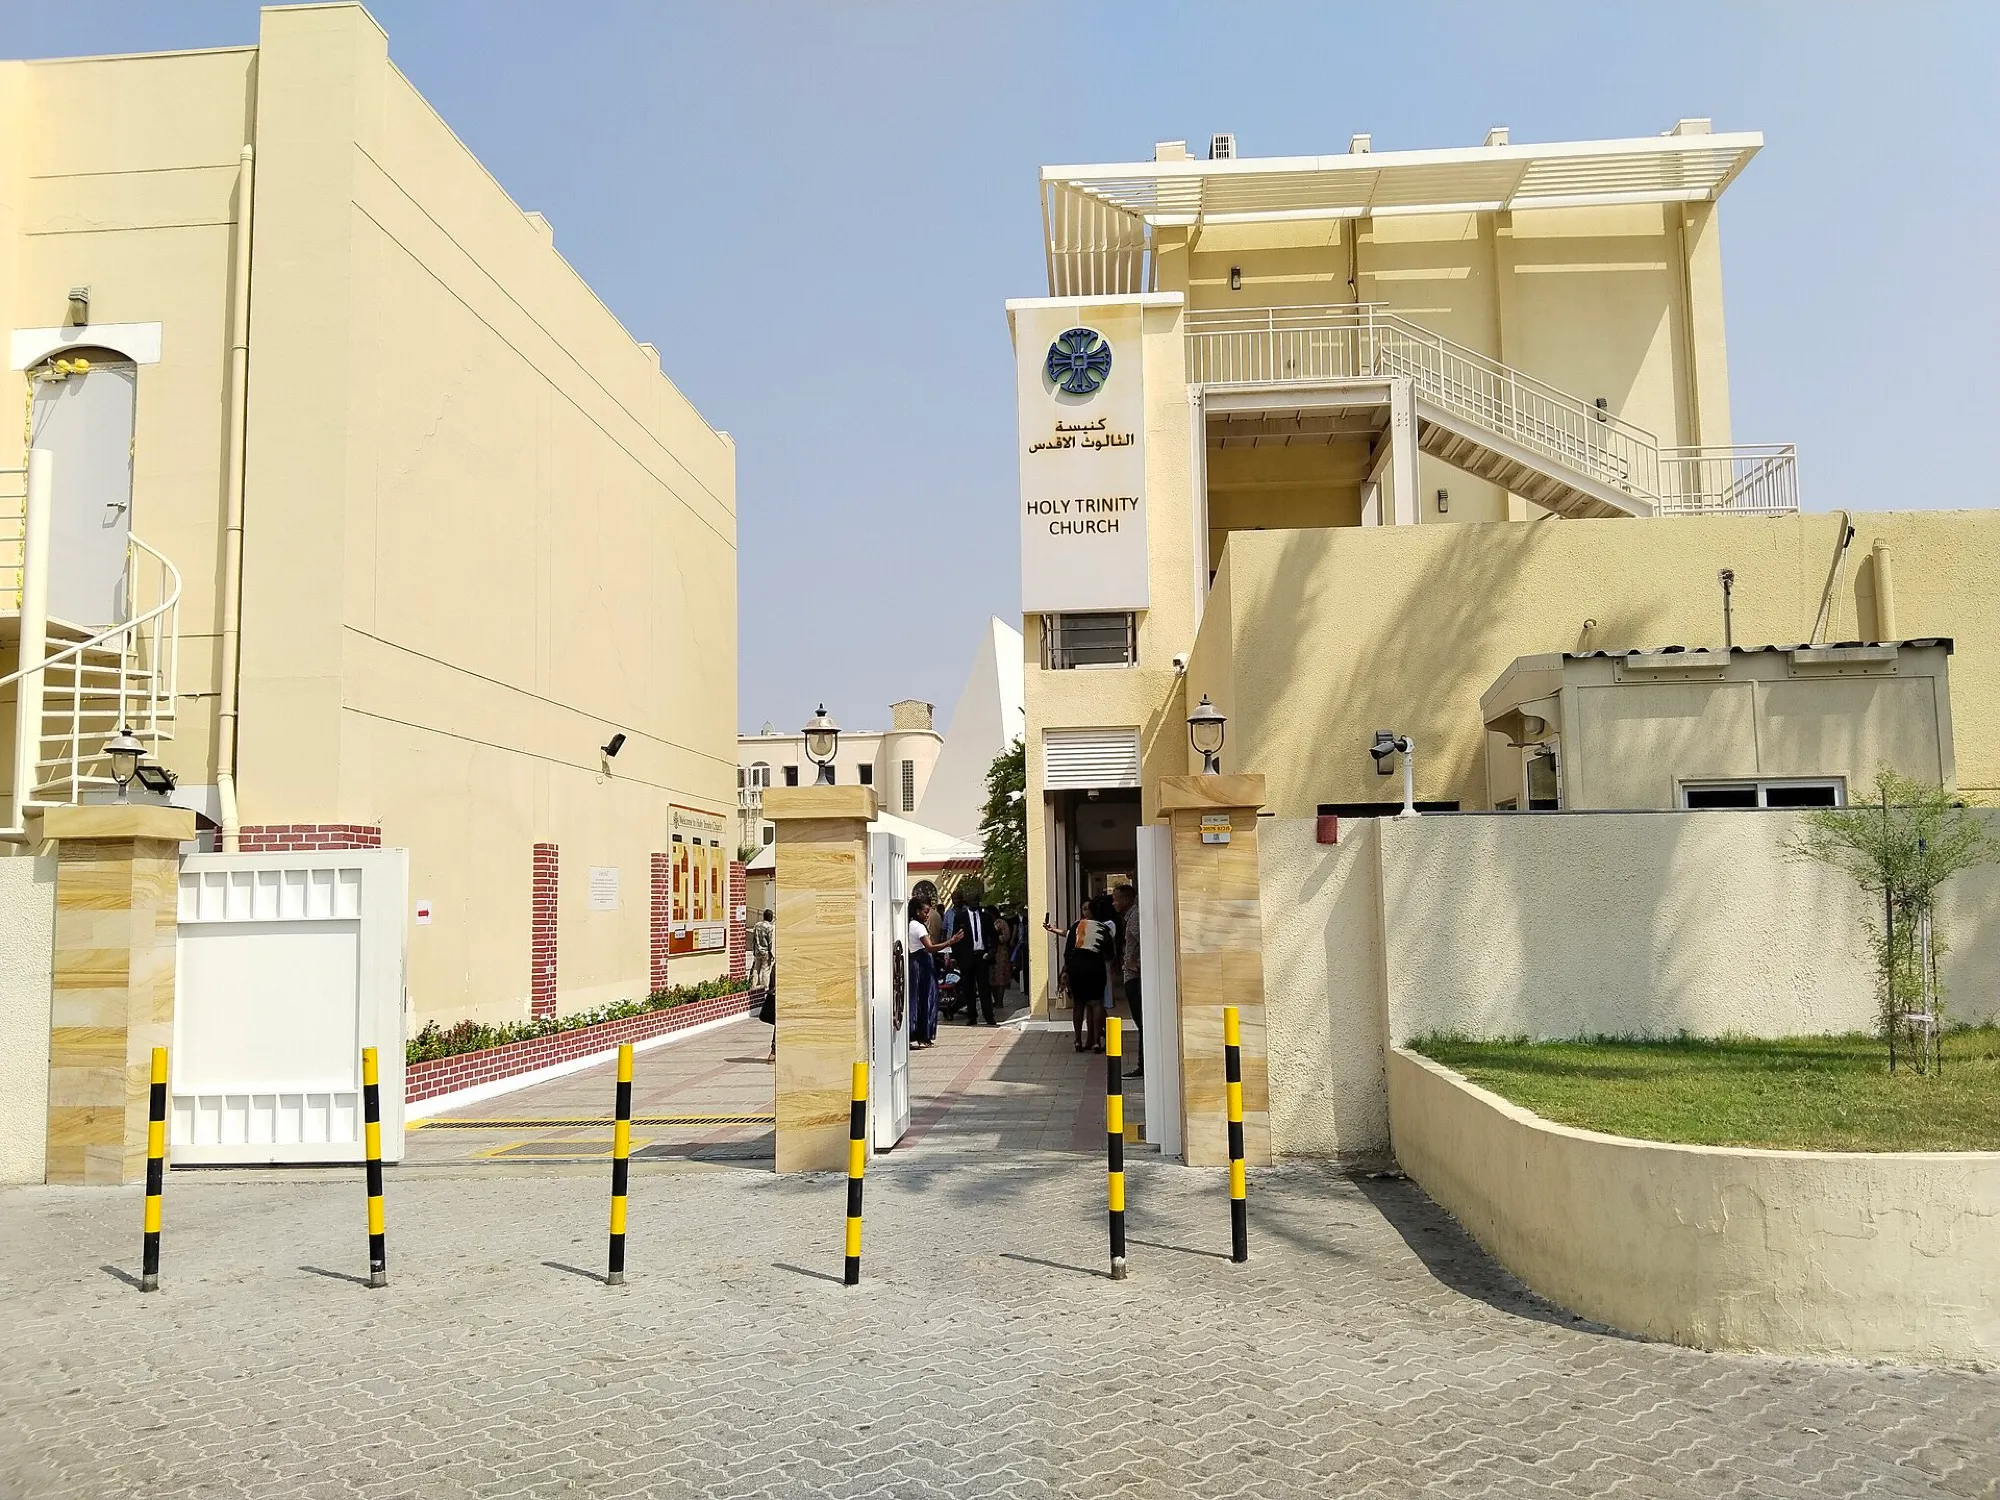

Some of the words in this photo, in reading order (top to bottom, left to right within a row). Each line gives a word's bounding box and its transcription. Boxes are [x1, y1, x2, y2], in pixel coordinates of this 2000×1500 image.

[1055, 418, 1107, 434] كنيسة
[1028, 435, 1076, 453] الاقدس
[1080, 433, 1134, 451] الثالوث
[1027, 499, 1071, 515] HOLY
[1075, 497, 1139, 513] TRINITY
[1049, 519, 1119, 535] CHURCH
